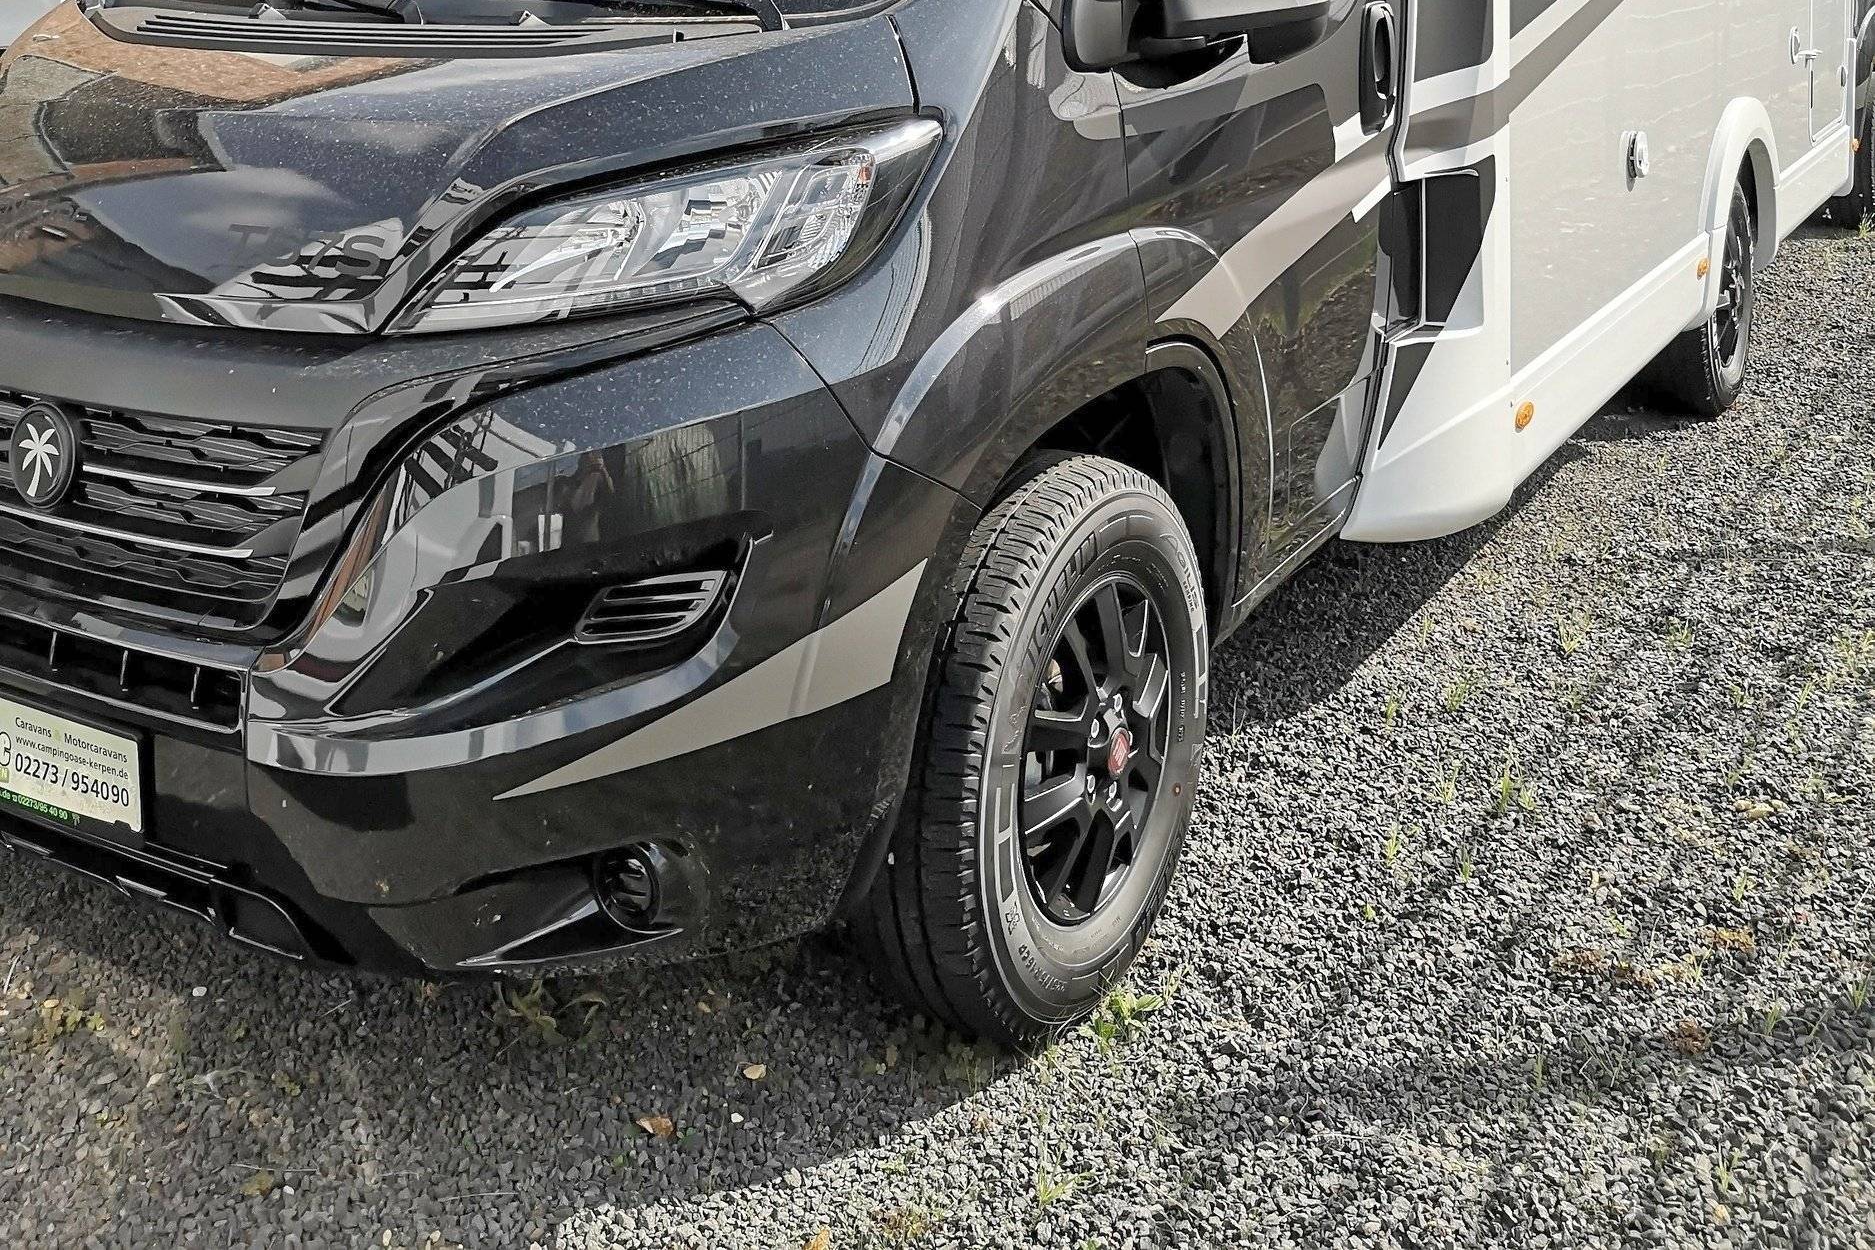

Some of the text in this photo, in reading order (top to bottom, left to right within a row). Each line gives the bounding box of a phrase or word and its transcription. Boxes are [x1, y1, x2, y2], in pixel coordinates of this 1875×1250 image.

[15, 716, 128, 763] Caravans Motorcaravans
[15, 735, 129, 780] www.campingoase-kerpen.de
[15, 752, 59, 784] 02273
[71, 771, 129, 807] 954090
[48, 806, 58, 817] 40
[59, 809, 68, 820] 90
